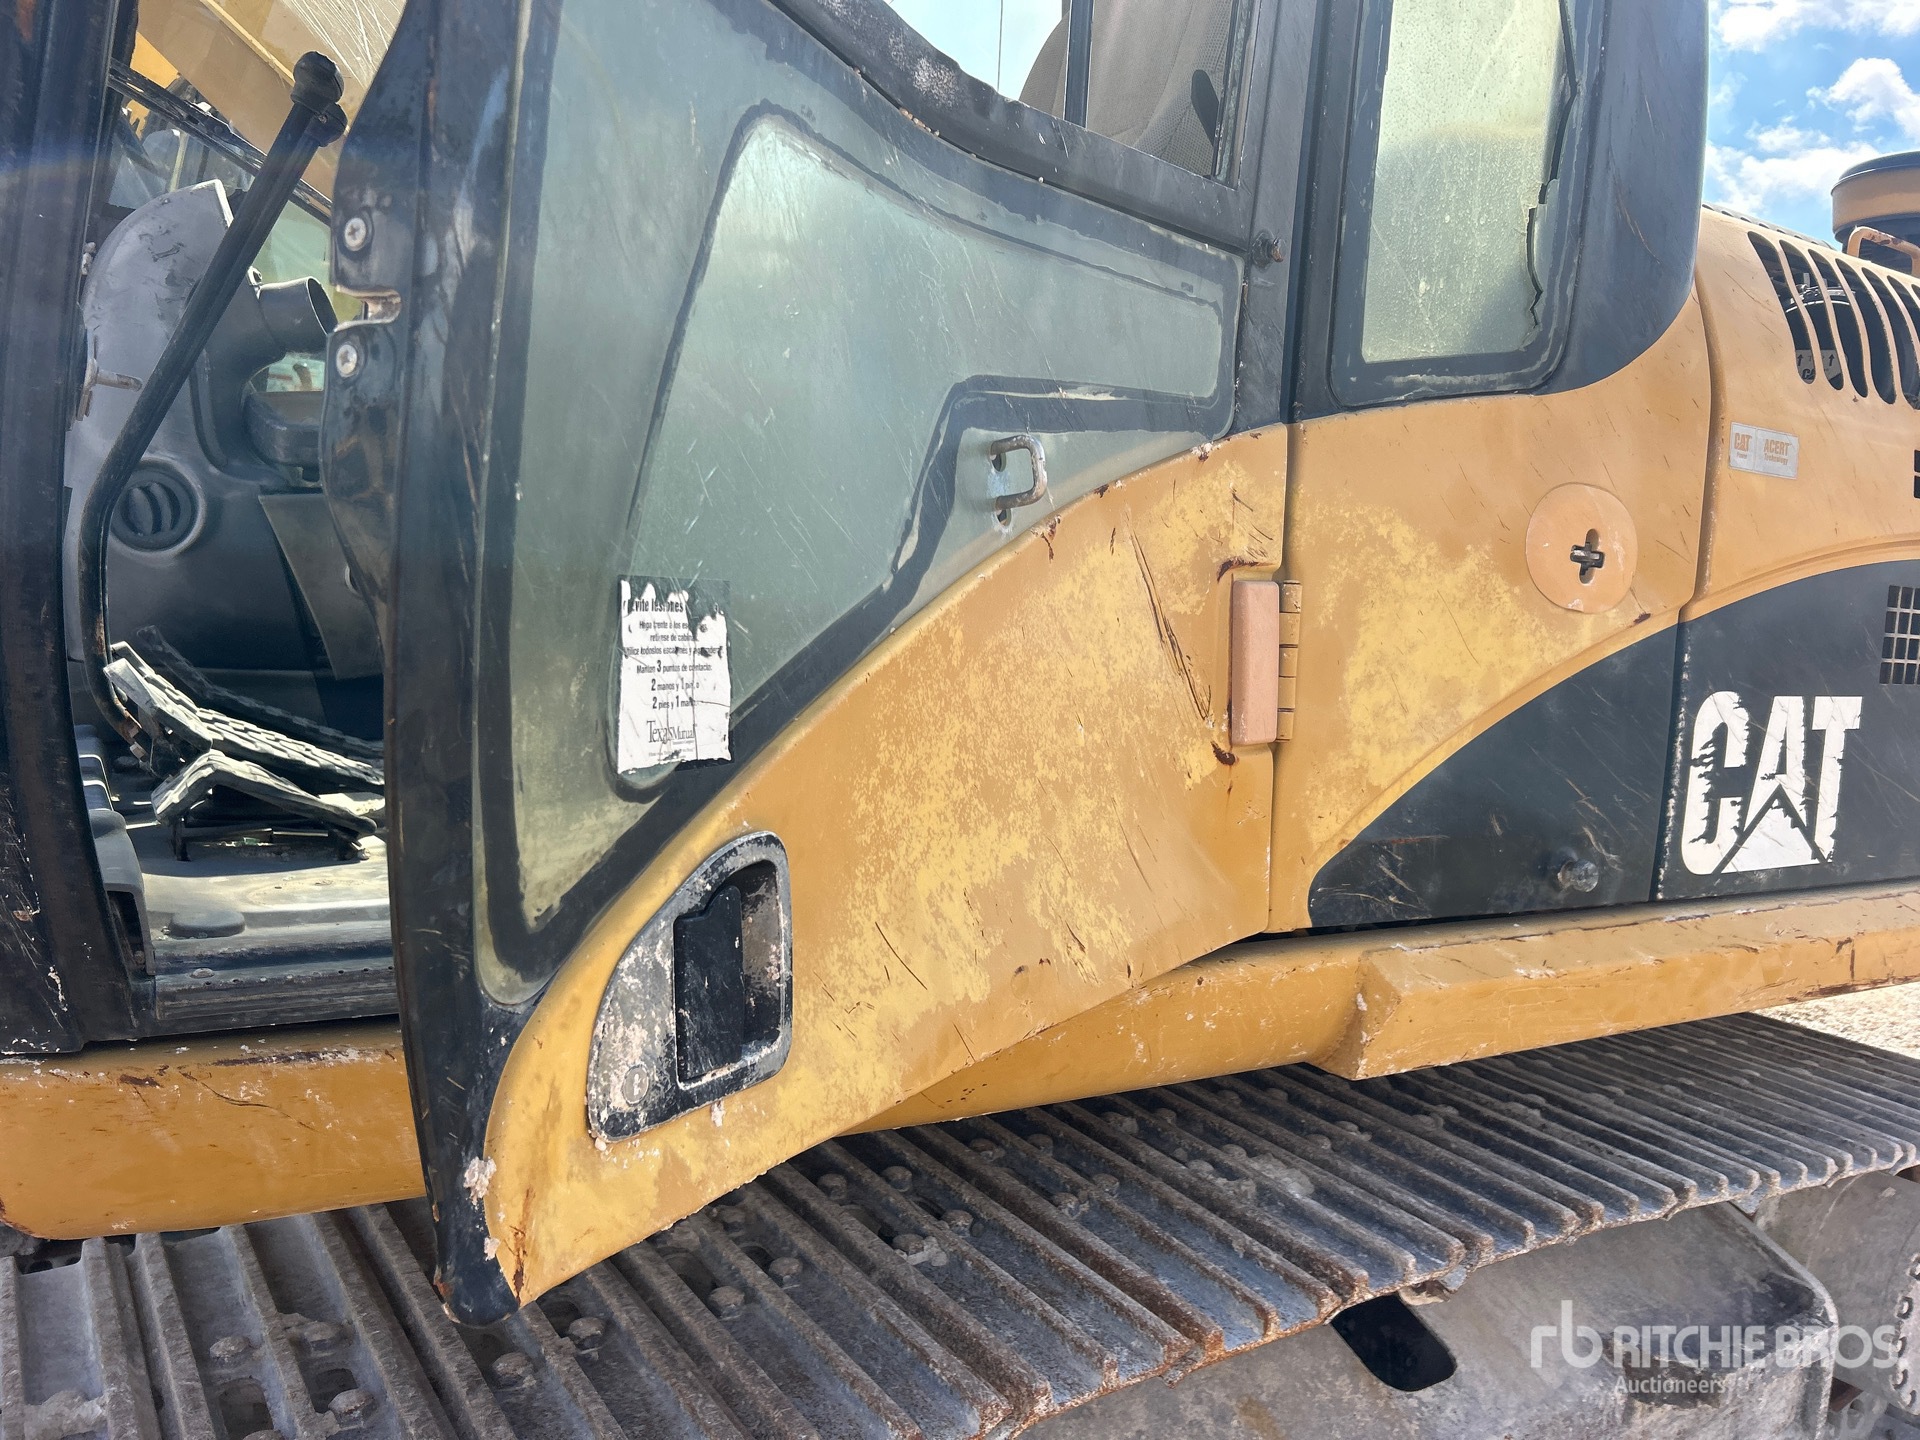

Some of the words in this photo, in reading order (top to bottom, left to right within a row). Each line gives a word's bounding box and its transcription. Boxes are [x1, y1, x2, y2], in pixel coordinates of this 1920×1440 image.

[1733, 432, 1752, 452] CAT
[1763, 438, 1790, 456] ACERT
[656, 660, 662, 672] 3
[681, 663, 688, 672] de
[651, 678, 656, 691] 2
[652, 696, 657, 709] 2
[658, 700, 670, 710] pies
[675, 695, 679, 708] 1
[1681, 690, 1863, 875] CAT
